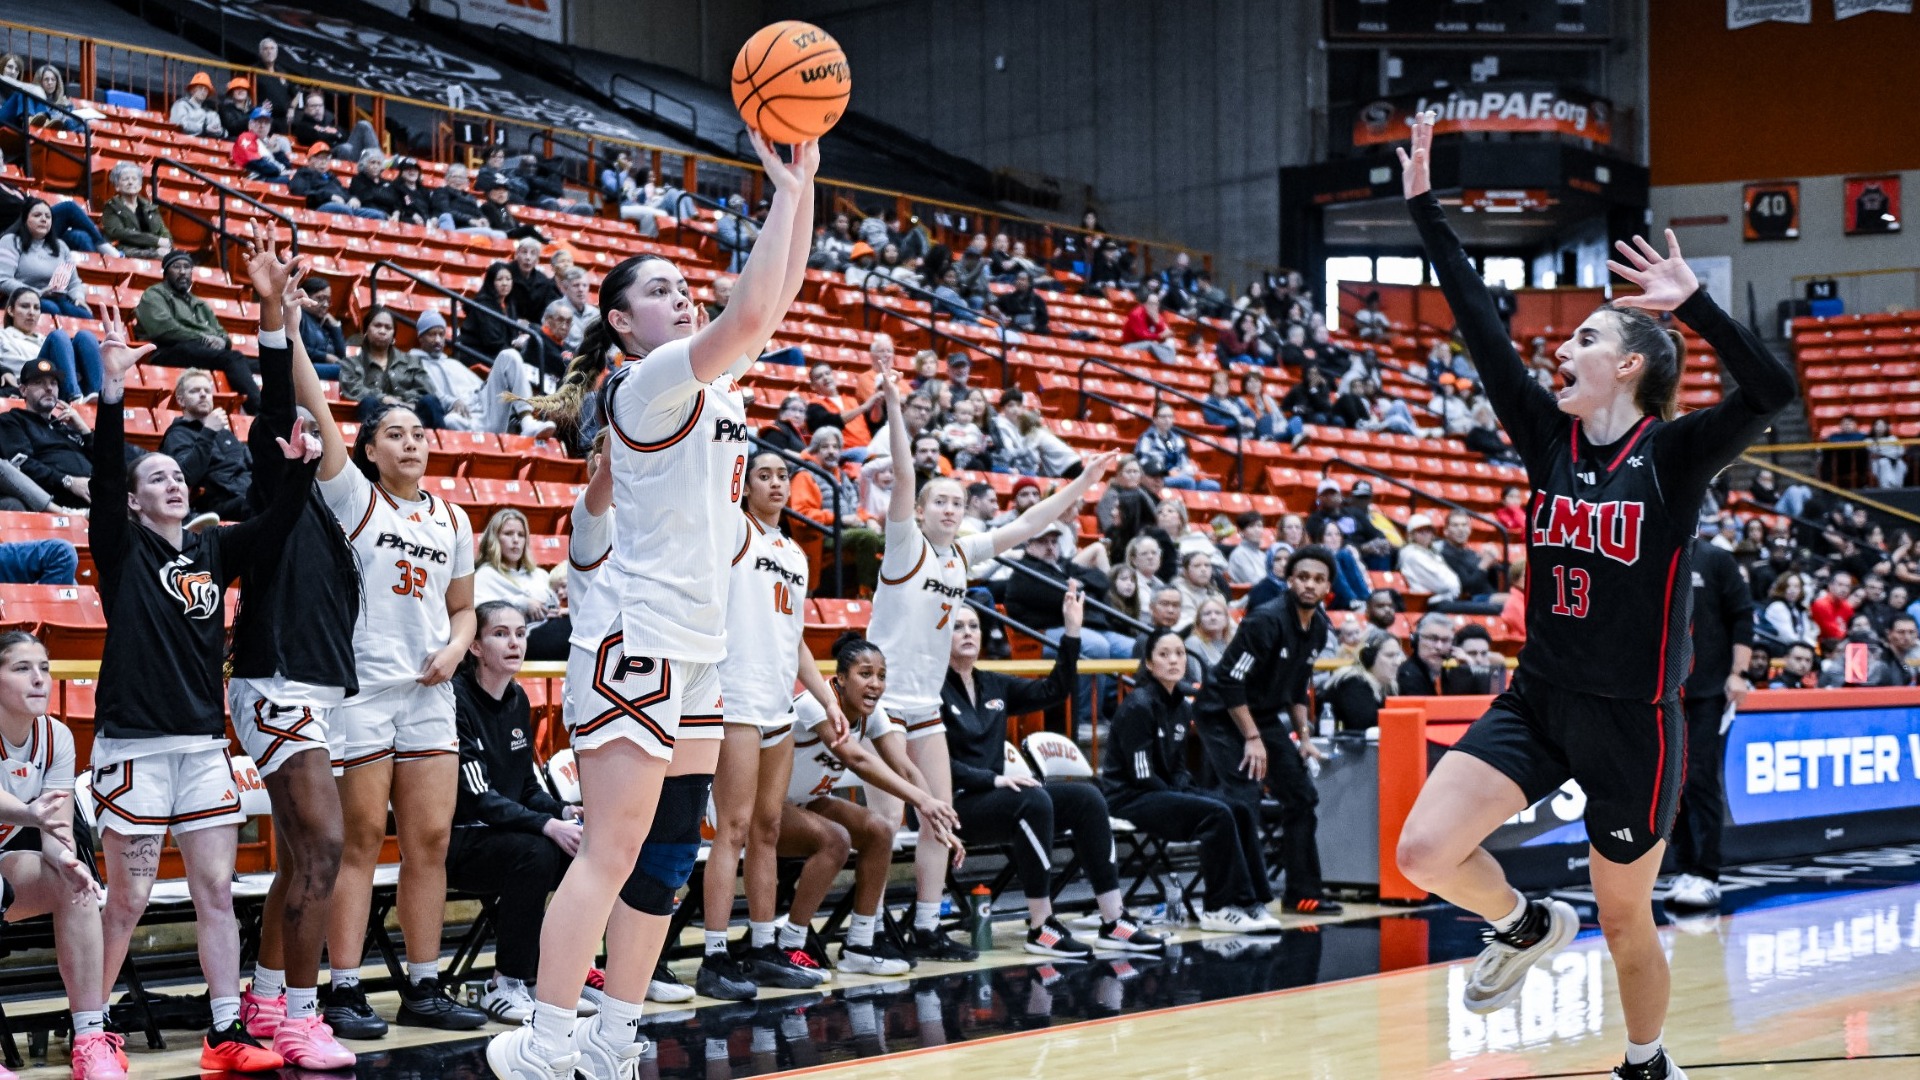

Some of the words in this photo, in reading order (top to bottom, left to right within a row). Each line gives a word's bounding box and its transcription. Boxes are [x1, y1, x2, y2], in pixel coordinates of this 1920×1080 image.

[1757, 194, 1786, 217] 40
[731, 454, 744, 503] 8
[1532, 488, 1644, 566] LMU
[375, 531, 448, 565] PACIFIC
[391, 559, 428, 601] 32
[1552, 564, 1591, 619] 13
[773, 581, 793, 616] 10
[936, 602, 952, 630] 7
[609, 650, 657, 683] P
[1037, 741, 1078, 762] PACIFIC
[1746, 734, 1900, 795] BETTER
[809, 775, 841, 795] 15
